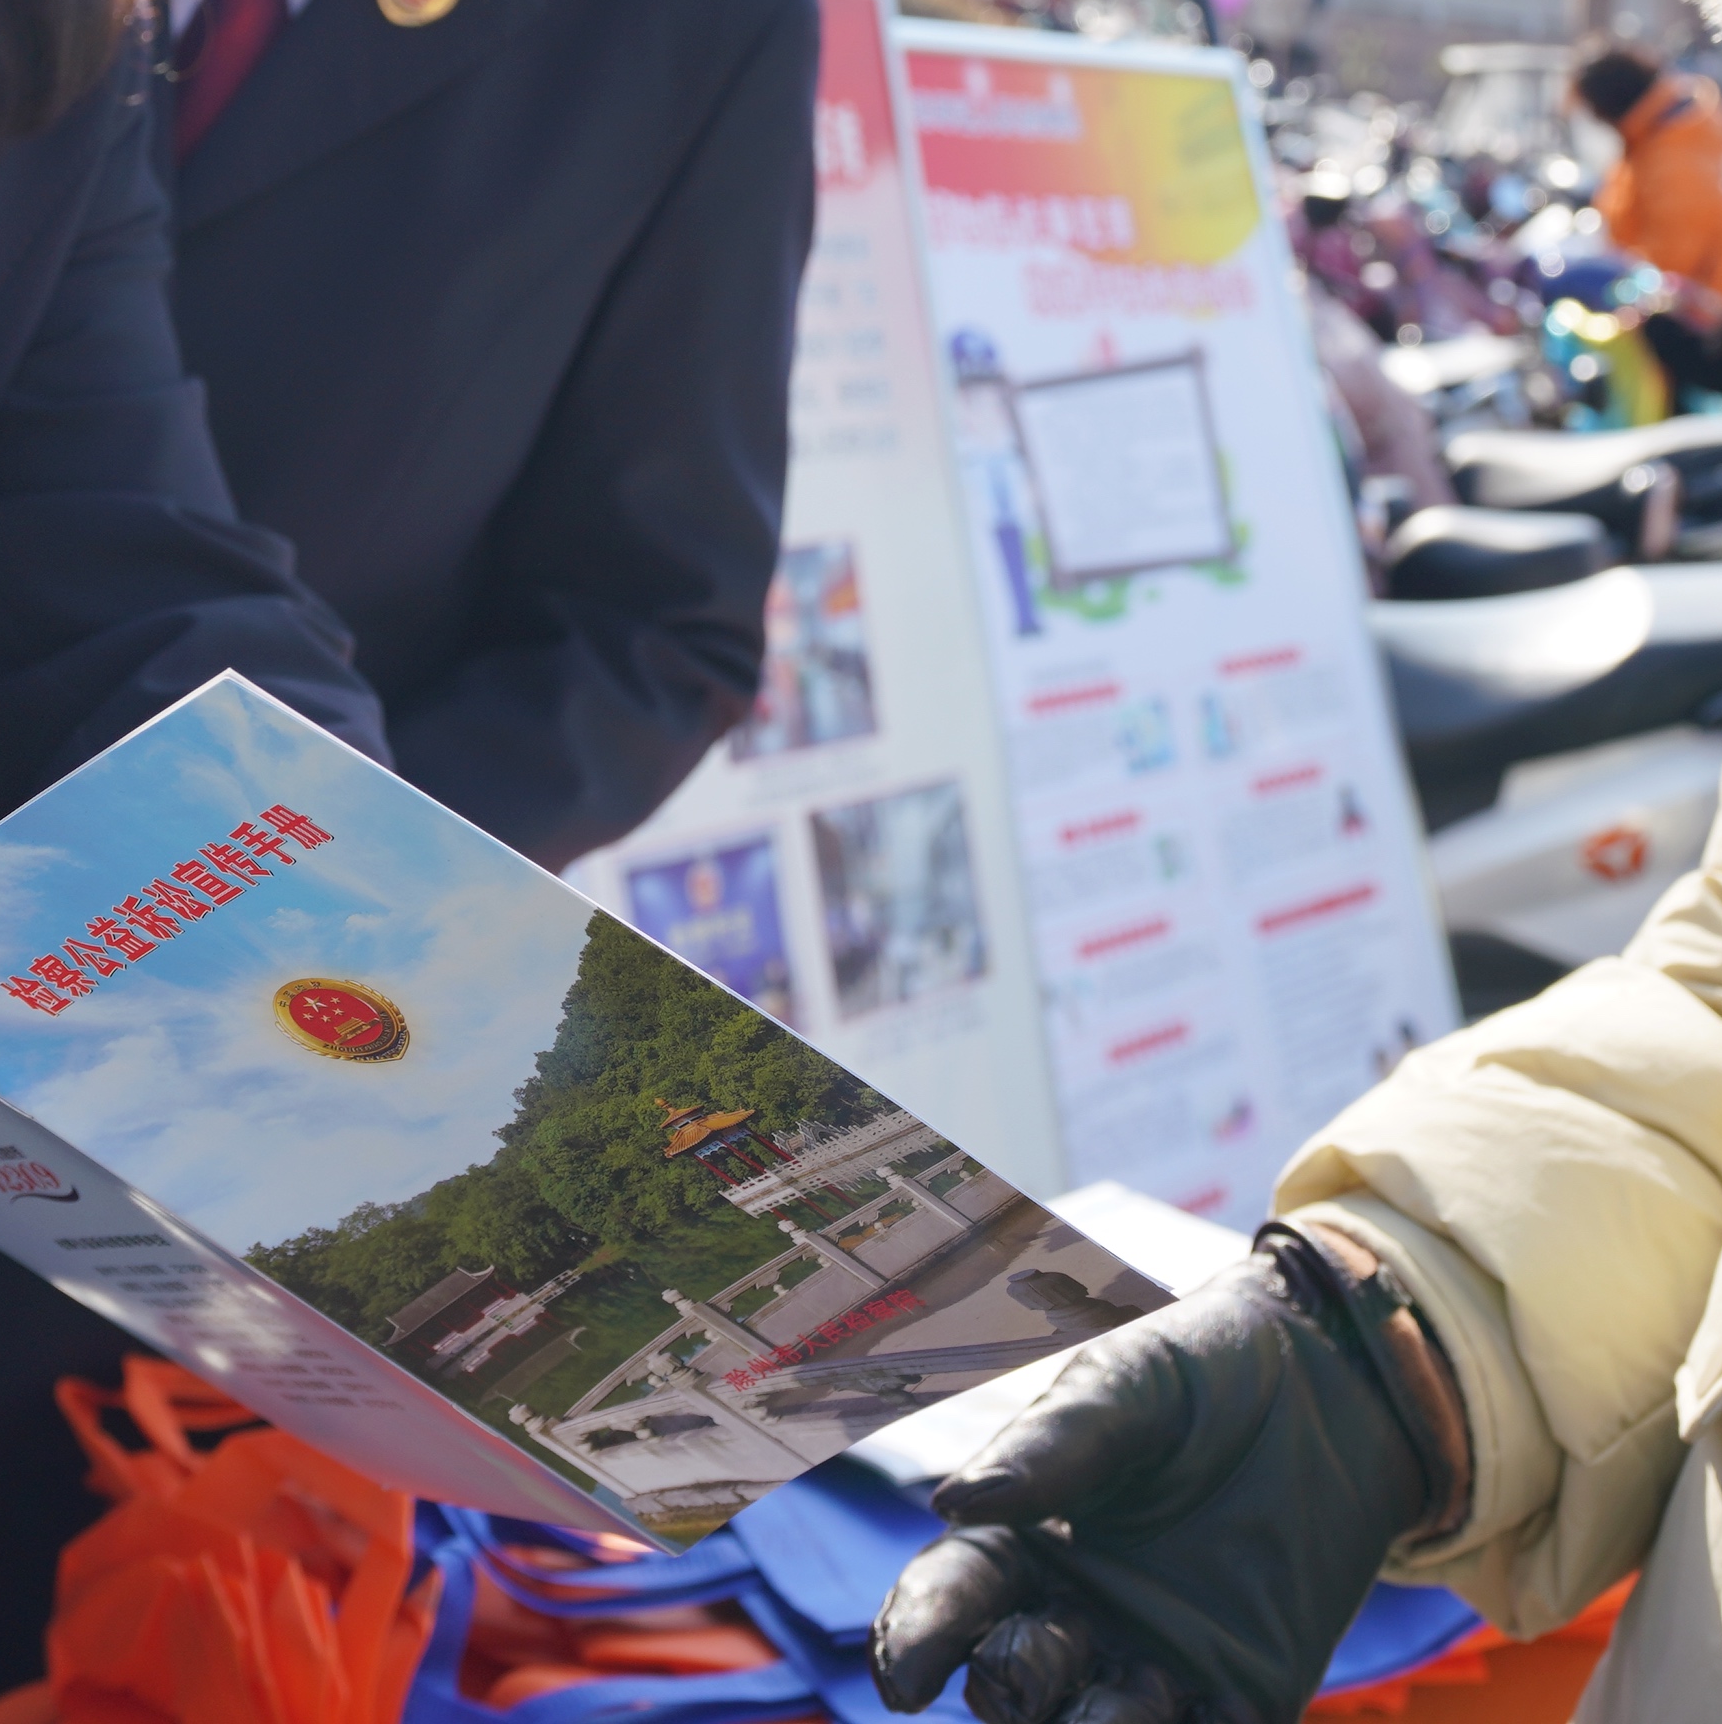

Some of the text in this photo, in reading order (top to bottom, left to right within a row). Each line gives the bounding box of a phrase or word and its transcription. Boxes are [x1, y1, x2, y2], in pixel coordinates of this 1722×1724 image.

[0, 803, 335, 1018] 检察公益诉讼宣传手册
[721, 1289, 926, 1392] 滁州市人民检察院
